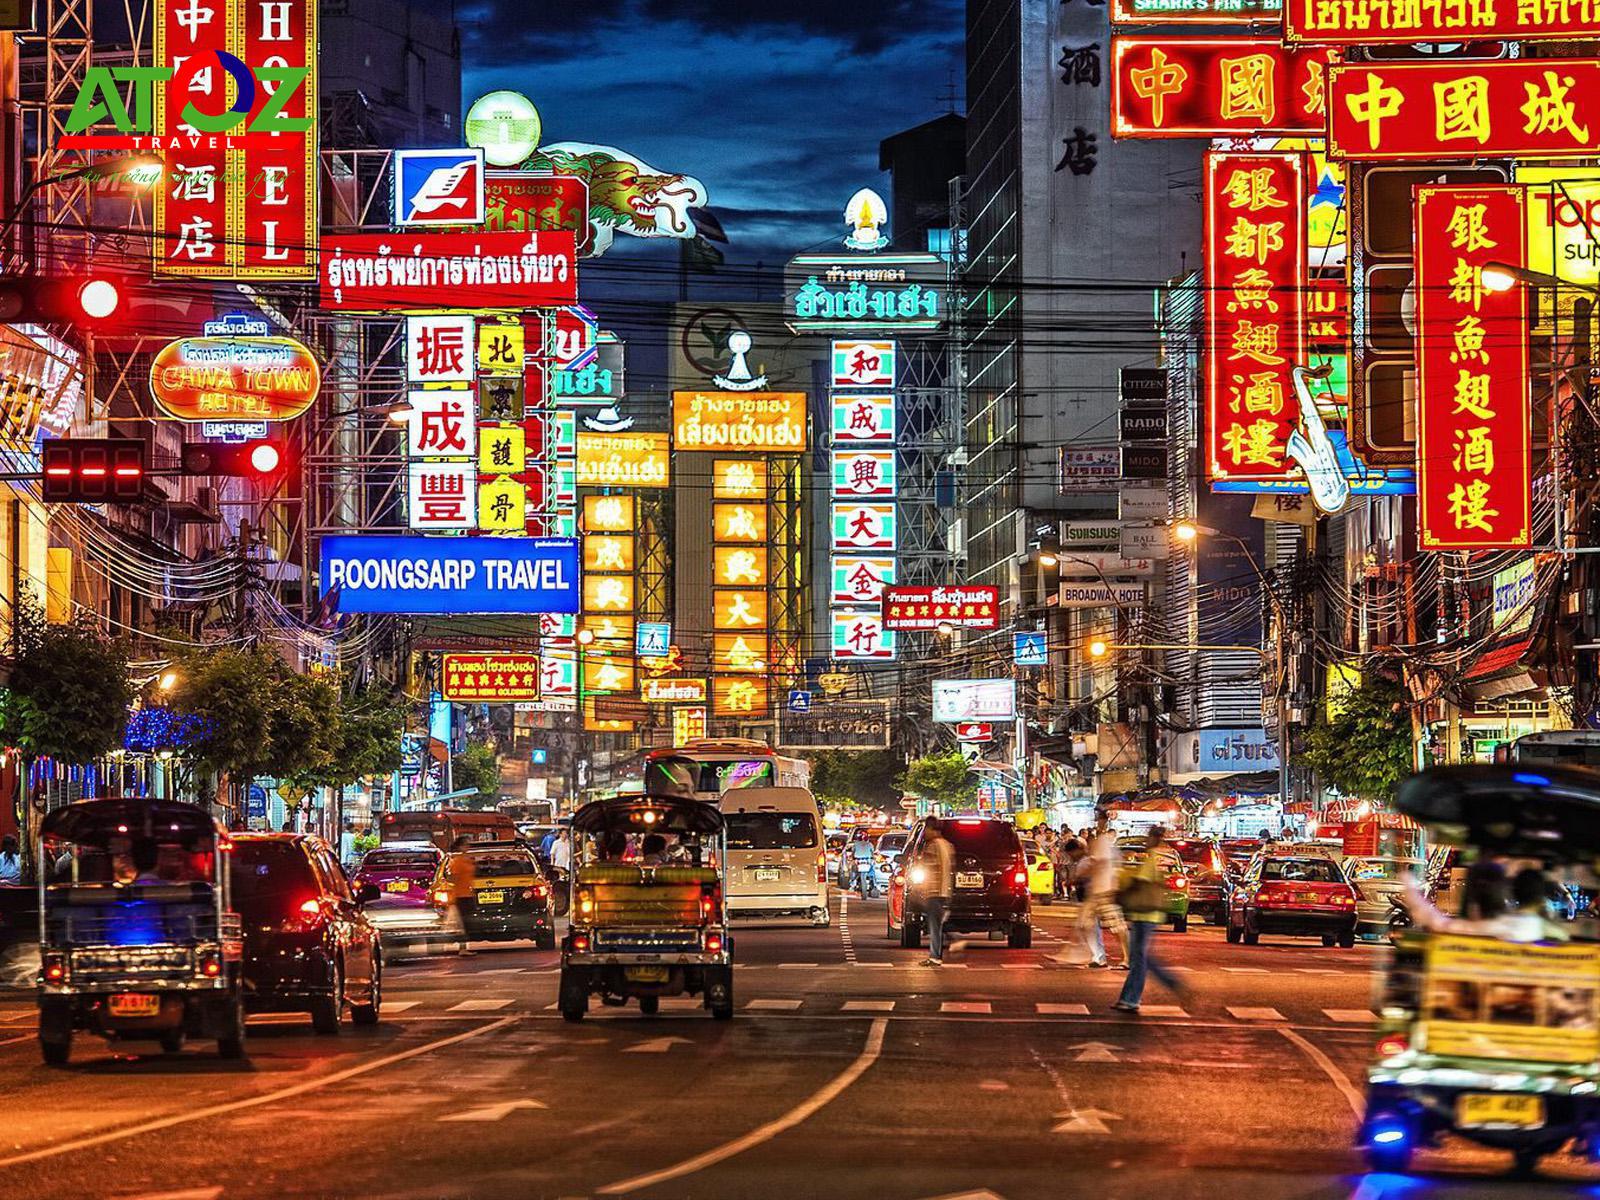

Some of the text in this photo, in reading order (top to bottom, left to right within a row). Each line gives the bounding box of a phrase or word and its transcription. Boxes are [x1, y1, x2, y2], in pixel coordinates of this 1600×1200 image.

[1345, 70, 1590, 150] 中國城
[171, 0, 216, 261] 中酒店
[259, 2, 294, 260] HOEL
[327, 233, 568, 304] รุ่งทรัพย์การท่องเที่ยว
[1221, 167, 1289, 468] 銀都魚翅酒樓
[161, 366, 313, 392] CHINA TOWN
[1123, 379, 1165, 389] CITIZEN
[1446, 203, 1500, 534] 銀都魚翅酒樓
[199, 392, 272, 414] HOTEL
[690, 394, 791, 413] ห้างขายทอง
[416, 326, 467, 522] 振成豐
[1124, 417, 1165, 428] RADO
[1129, 456, 1160, 465] MIDO
[848, 349, 882, 652] 和成興大金行
[1133, 535, 1157, 543] BALL
[329, 558, 570, 590] ROONGSARP TRAVEL
[1065, 588, 1117, 601] BROADWAY
